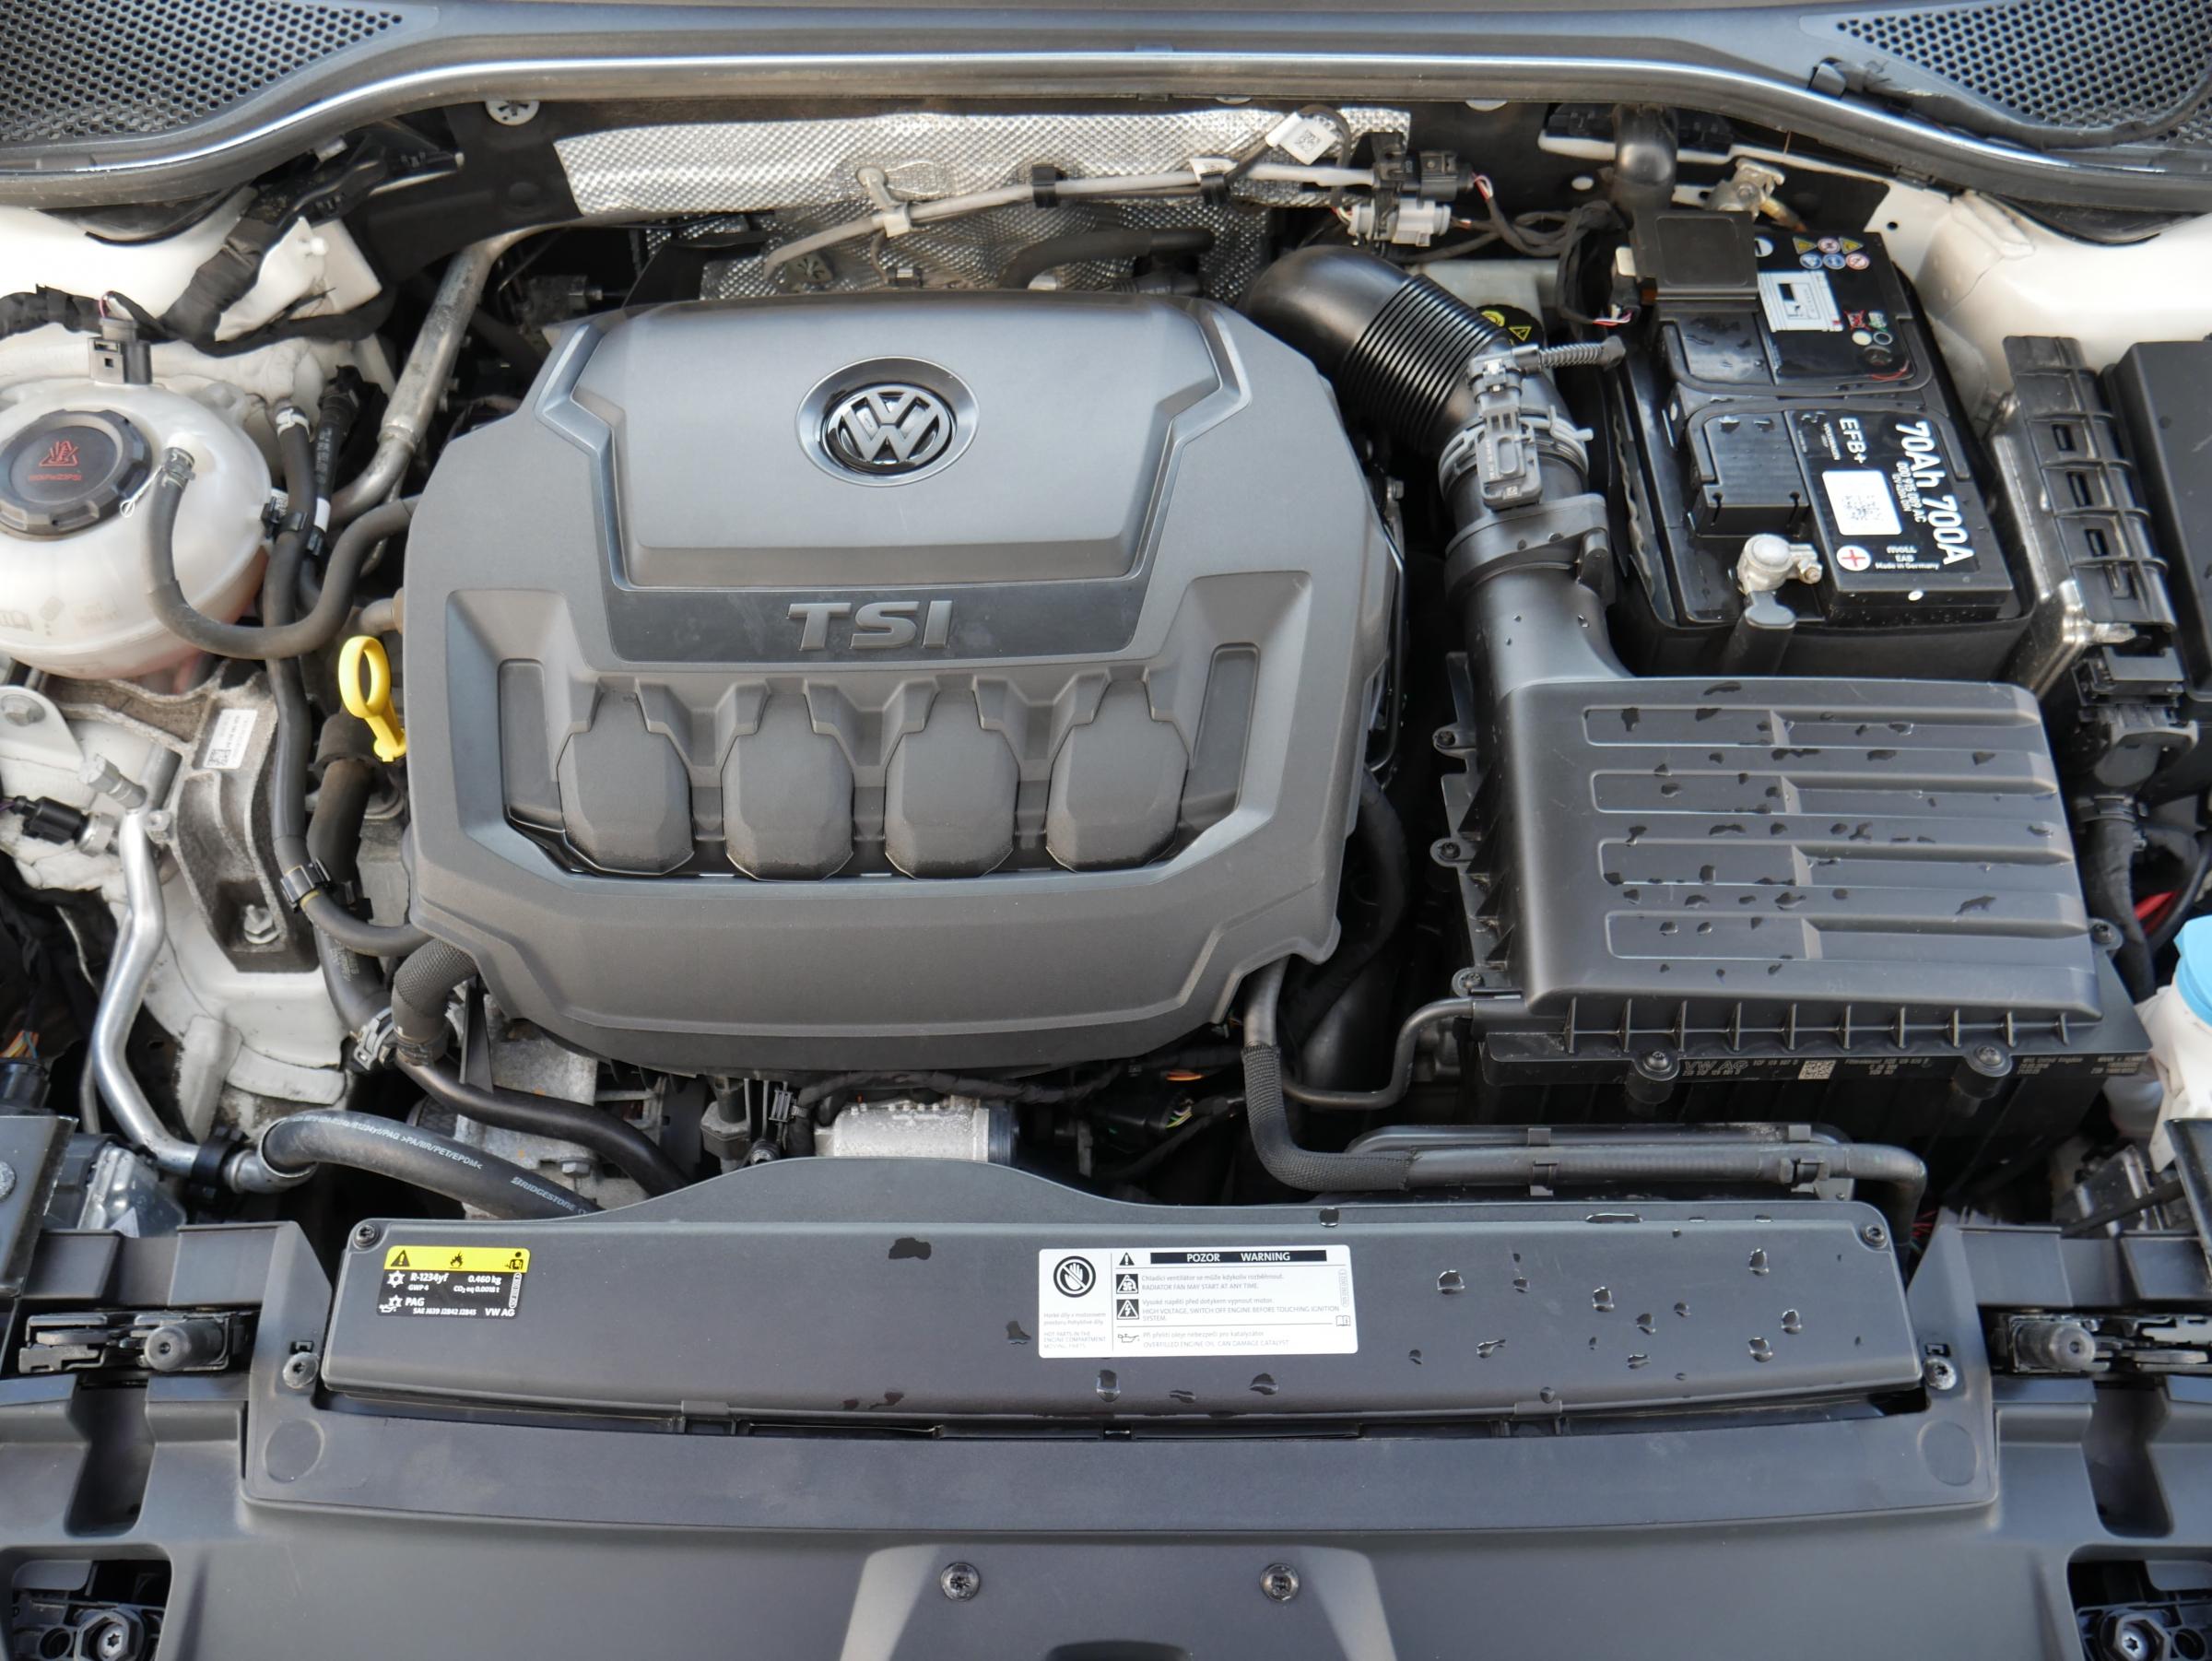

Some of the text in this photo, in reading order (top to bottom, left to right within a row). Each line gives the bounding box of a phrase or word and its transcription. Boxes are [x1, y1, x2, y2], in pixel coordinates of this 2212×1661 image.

[1838, 417, 1867, 463] EFB+
[1895, 420, 1974, 565] 70Ah 700A
[787, 600, 953, 651] TSI
[511, 1176, 576, 1212] BRIDGESTONE
[1187, 1252, 1291, 1262] POZOR WARNING
[410, 1273, 449, 1285] R-1234yf
[491, 1276, 502, 1285] kg
[405, 1298, 425, 1306] PAG
